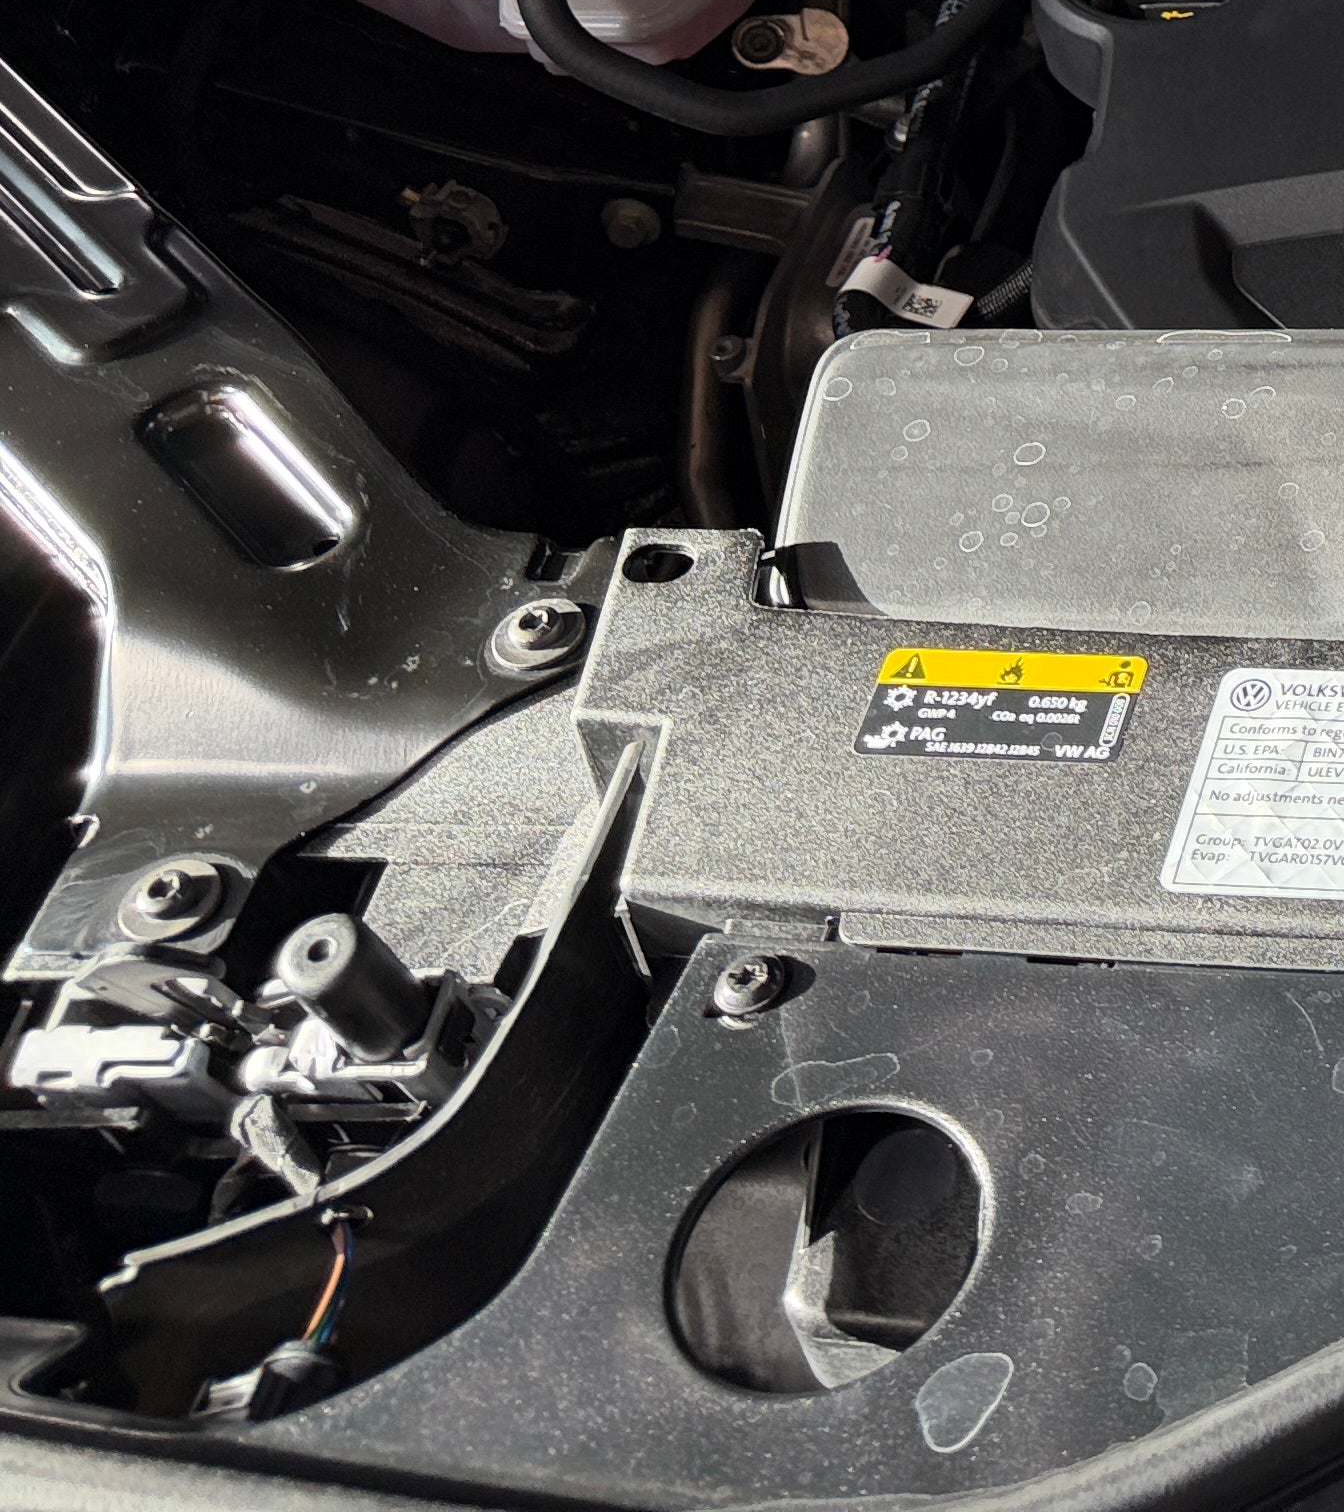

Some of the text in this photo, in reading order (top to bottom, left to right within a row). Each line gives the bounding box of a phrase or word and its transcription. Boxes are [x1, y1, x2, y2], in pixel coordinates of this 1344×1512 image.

[923, 690, 1088, 712] R-1234yf 0.650 kg
[1275, 700, 1330, 712] VEHICLE
[1019, 713, 1034, 725] eq
[909, 727, 947, 741] PAG
[1229, 723, 1297, 735] Conforms
[1302, 724, 1316, 736] to
[1054, 745, 1110, 760] VW AG
[1209, 790, 1229, 802] No
[1233, 790, 1323, 805] adjustments
[1196, 834, 1246, 850] Group:
[1191, 849, 1230, 864] Evap:
